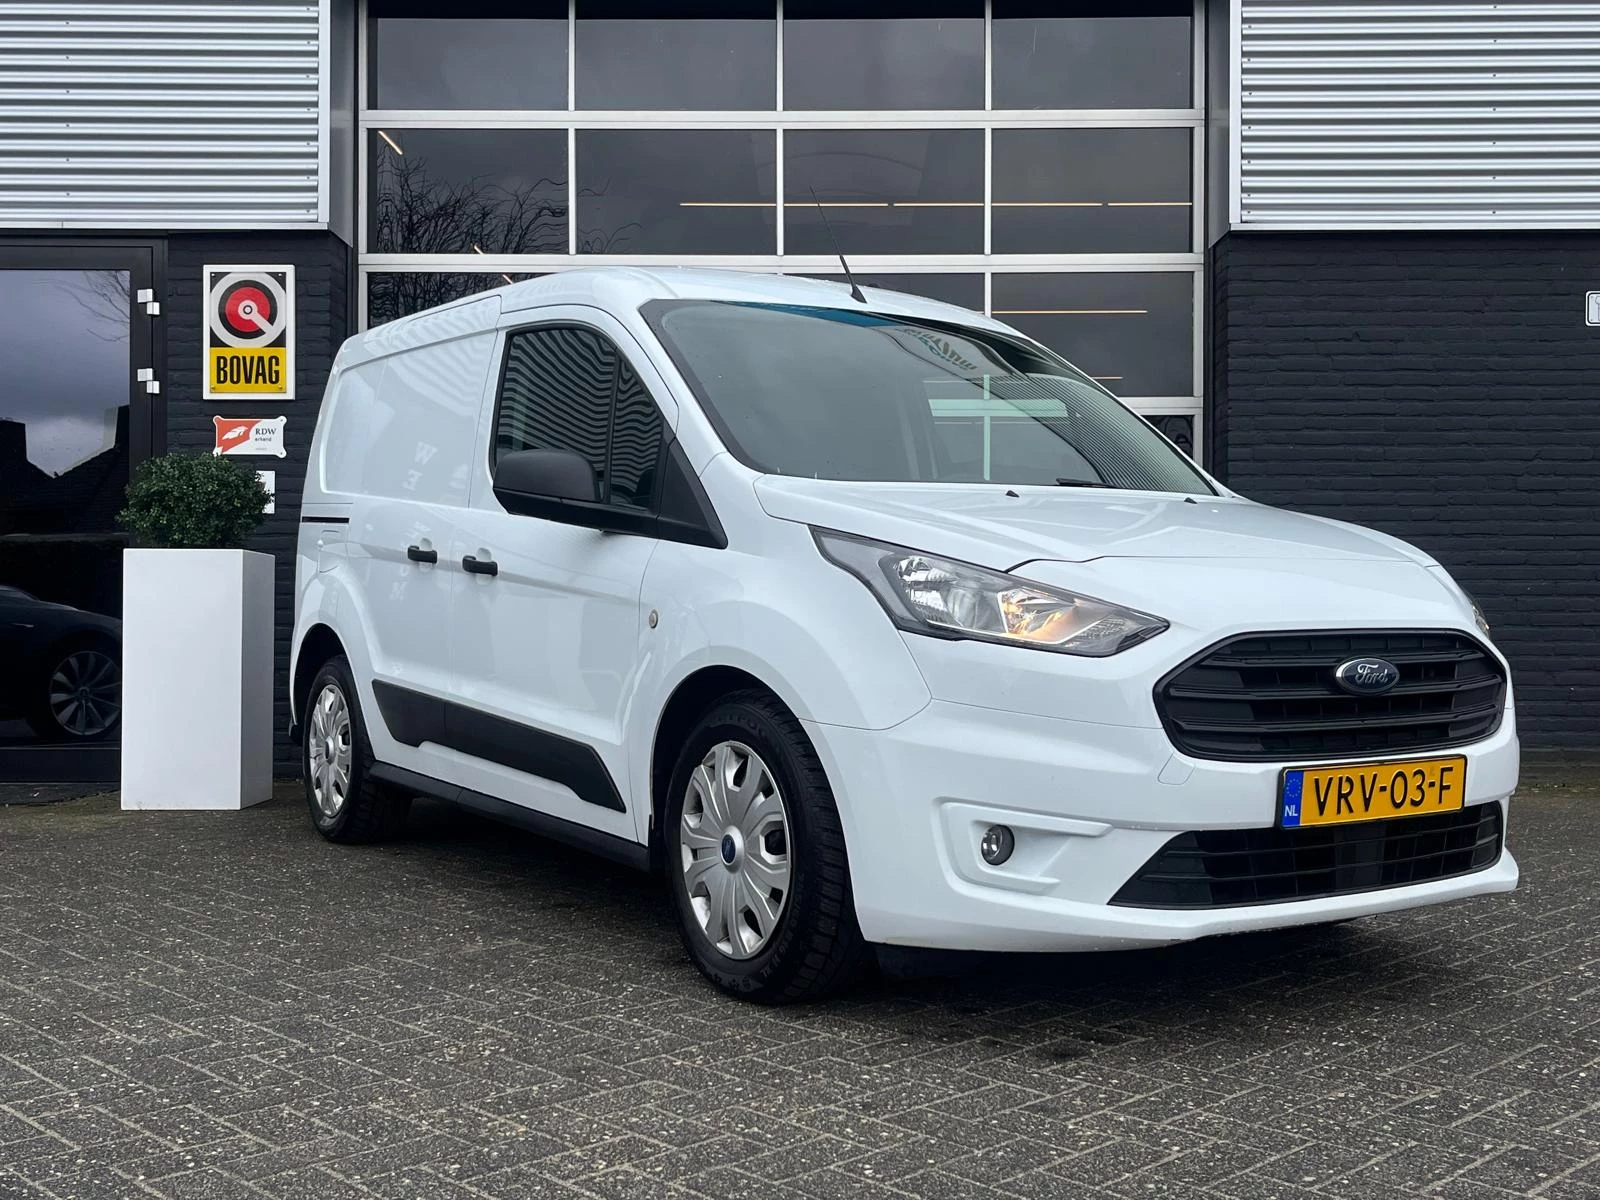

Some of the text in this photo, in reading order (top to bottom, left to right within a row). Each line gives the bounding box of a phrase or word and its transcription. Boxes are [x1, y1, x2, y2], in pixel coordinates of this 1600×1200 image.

[216, 355, 280, 385] BOVAG
[255, 427, 277, 436] RDW
[1355, 663, 1389, 684] Ford
[1313, 766, 1454, 817] VRV-03-F
[1284, 804, 1299, 817] NL
